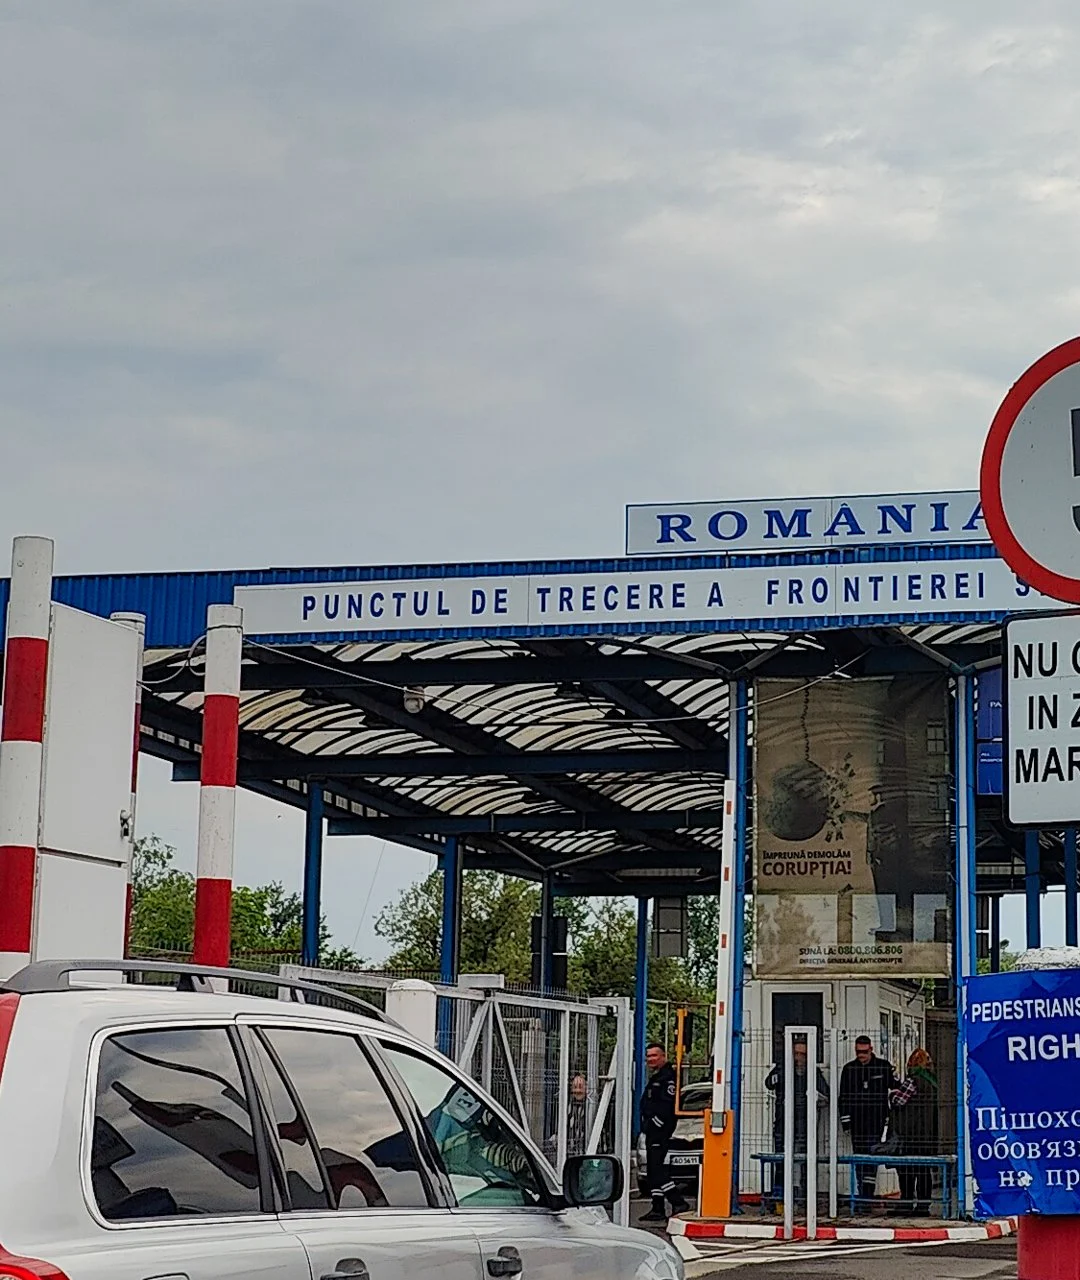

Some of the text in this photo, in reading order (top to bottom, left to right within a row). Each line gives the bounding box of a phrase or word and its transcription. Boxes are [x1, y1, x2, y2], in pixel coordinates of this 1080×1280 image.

[302, 589, 450, 620] PUNCTUL
[470, 588, 508, 615] DE
[537, 583, 686, 613] TRECERE
[707, 581, 724, 607] A
[766, 572, 985, 605] FRONTIEREI
[1013, 641, 1059, 679] NU
[1028, 694, 1058, 730] IN
[807, 849, 851, 859] DEMOLĂM
[762, 860, 852, 879] CORUPȚIA!
[998, 1170, 1033, 1188] на
